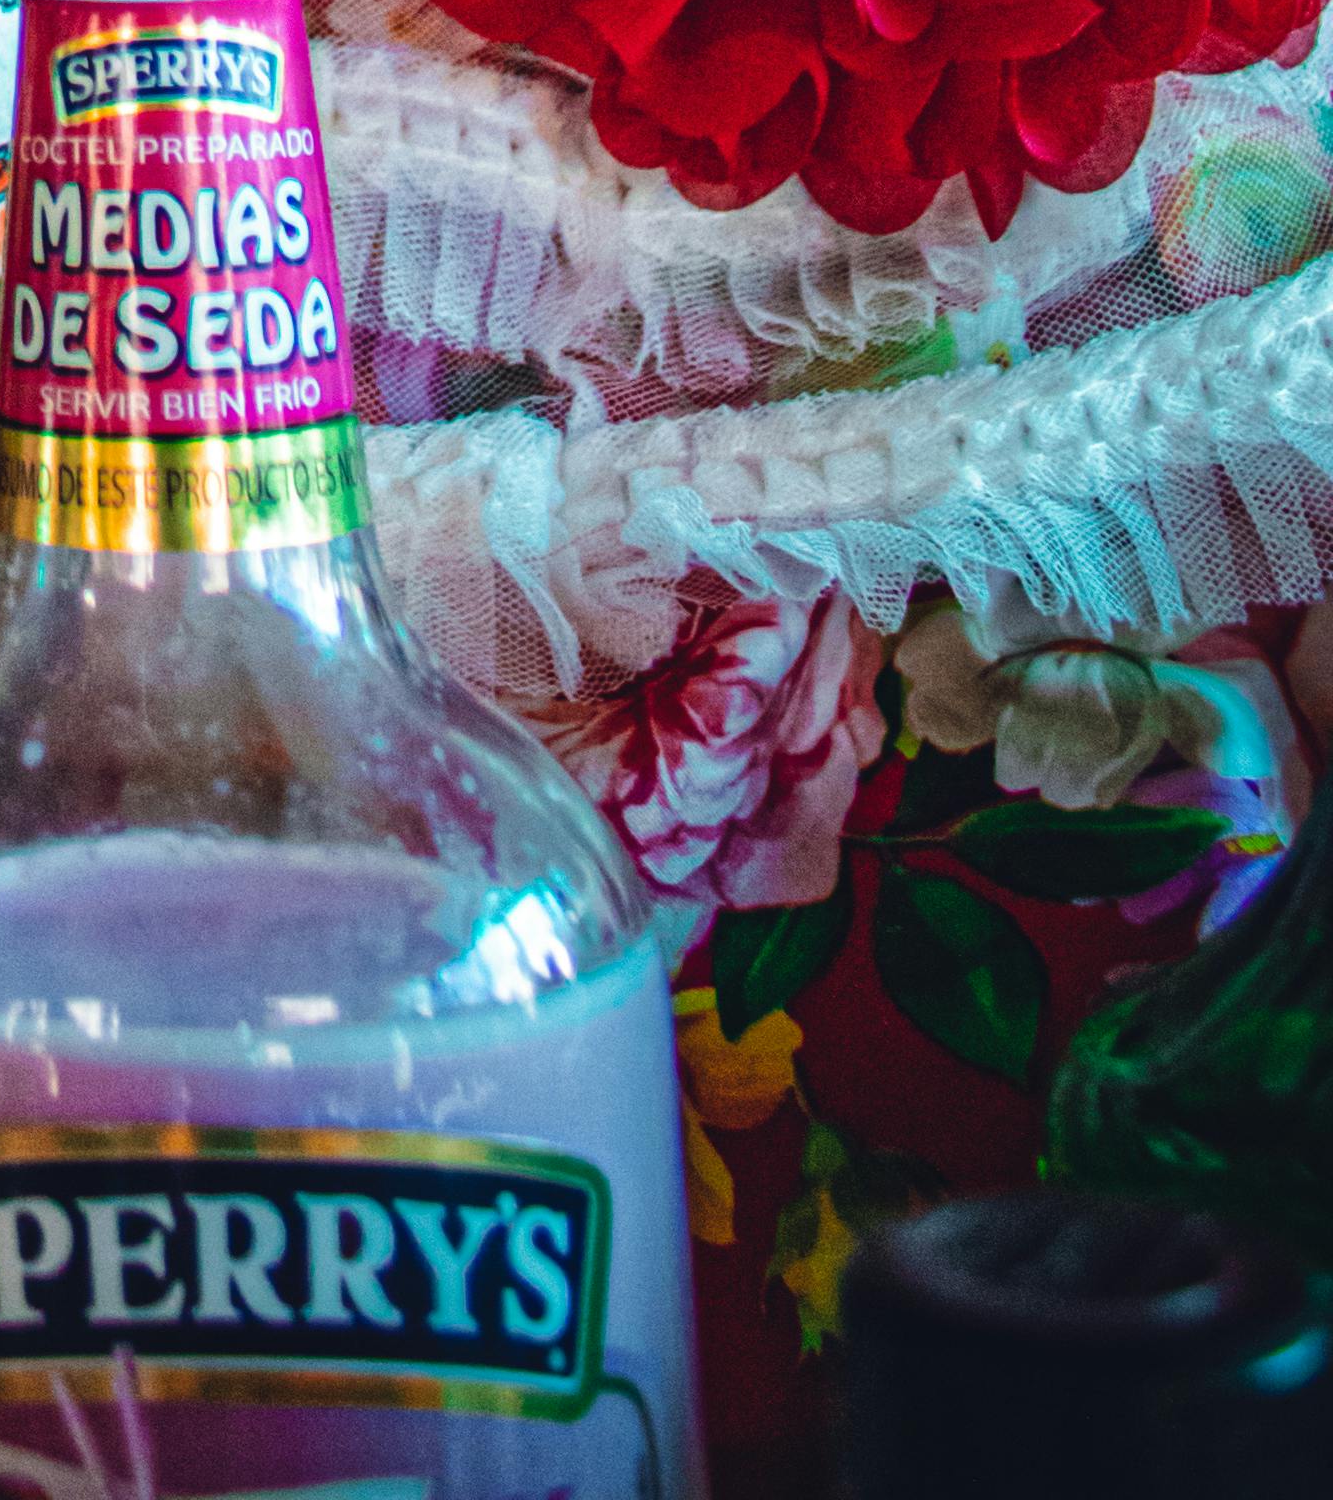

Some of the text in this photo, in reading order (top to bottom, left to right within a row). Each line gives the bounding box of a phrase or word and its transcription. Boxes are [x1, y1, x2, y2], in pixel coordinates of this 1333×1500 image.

[65, 48, 272, 103] SPERRY'S
[20, 127, 315, 165] COCTEL PREPARADO
[32, 177, 310, 270] MEDIAS
[12, 276, 337, 374] DE SEDA
[40, 376, 321, 422] SERVIR BIEN FRÍO
[97, 465, 158, 510] ESTE
[165, 461, 311, 510] PRODUCTO
